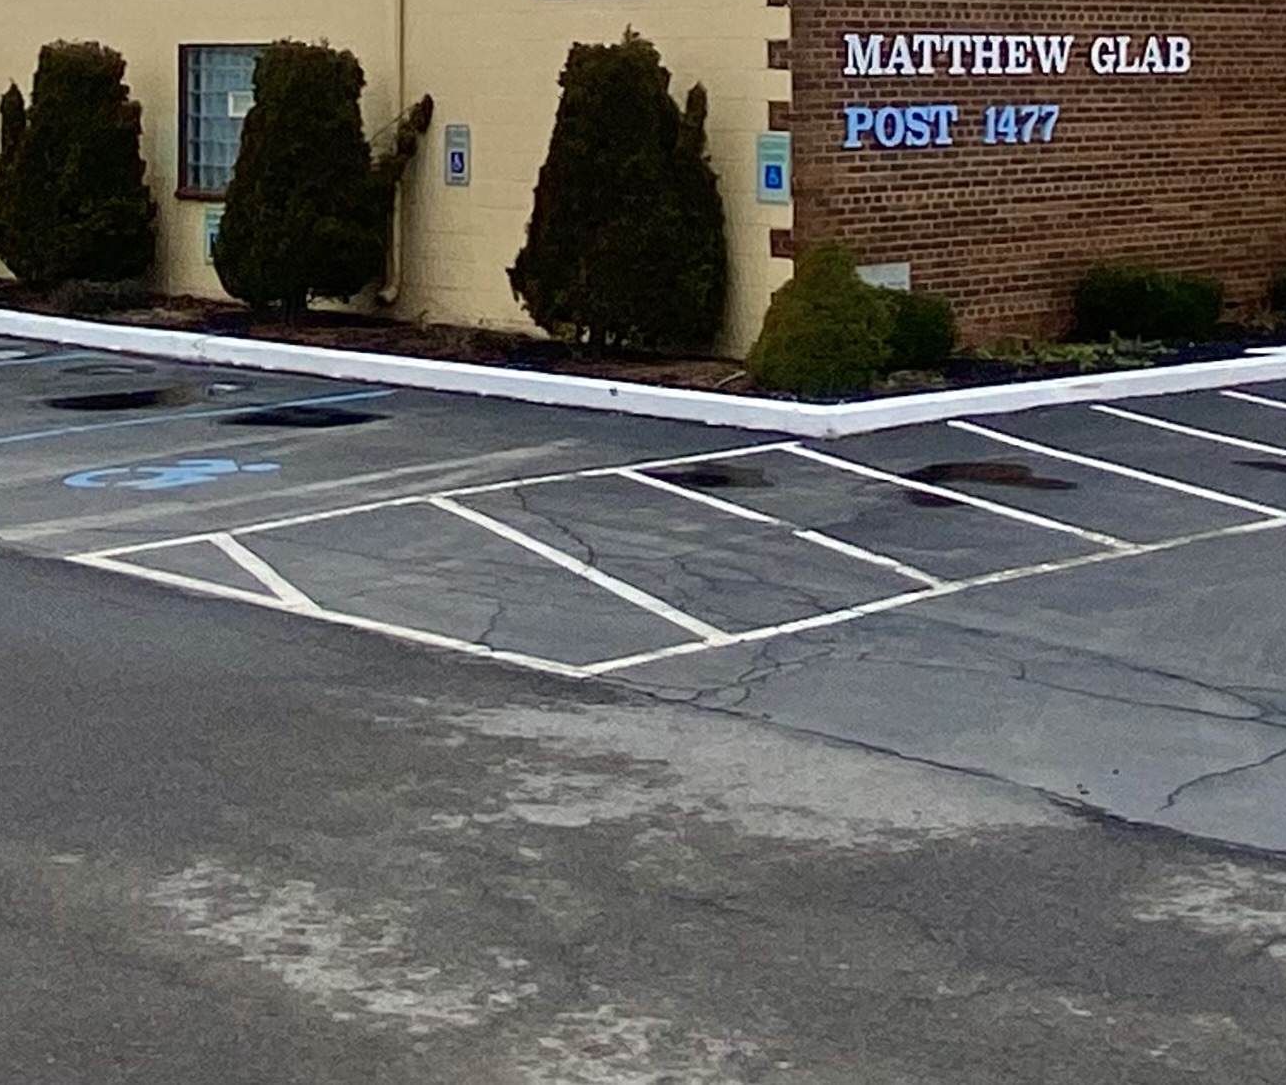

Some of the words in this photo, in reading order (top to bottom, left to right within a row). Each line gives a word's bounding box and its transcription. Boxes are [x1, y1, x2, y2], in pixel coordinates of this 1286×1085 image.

[843, 33, 1074, 76] MATTHEW
[1090, 35, 1192, 75] GLAB
[843, 104, 958, 149] POST
[983, 105, 1061, 145] 1477
